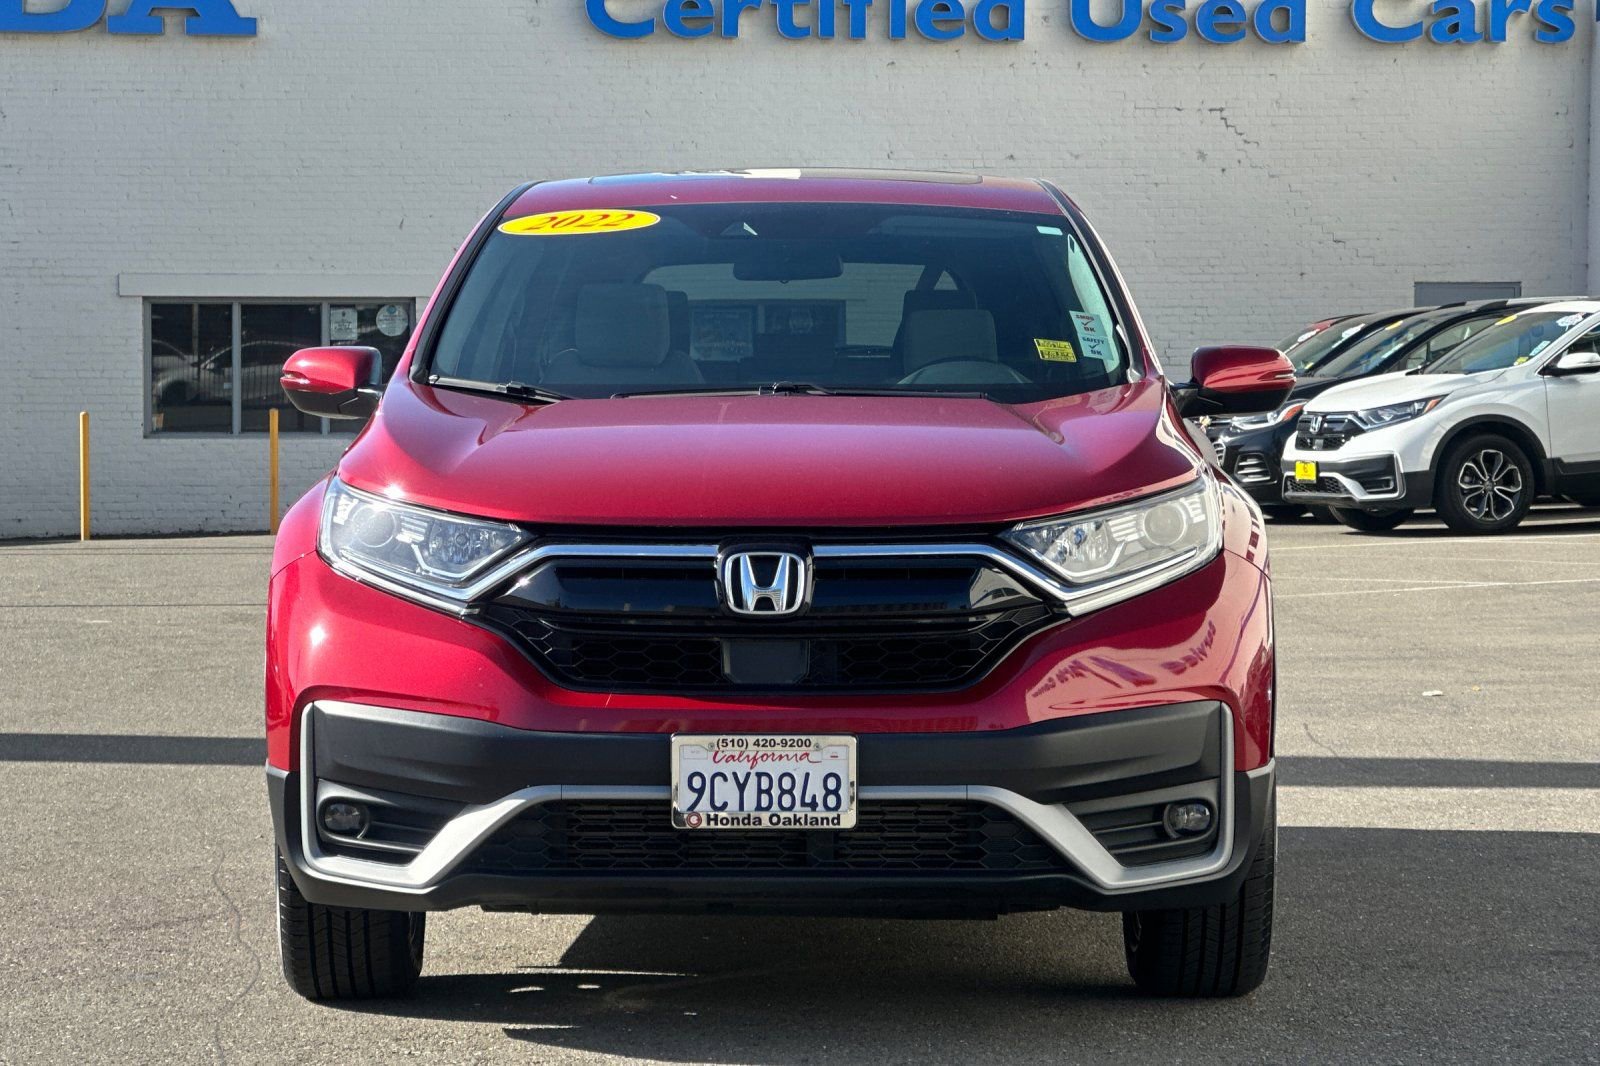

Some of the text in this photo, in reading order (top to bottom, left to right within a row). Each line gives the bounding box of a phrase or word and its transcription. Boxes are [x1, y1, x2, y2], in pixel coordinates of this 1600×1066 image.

[585, 0, 1575, 44] Certified Used Cars
[523, 213, 636, 231] 2022
[1082, 336, 1105, 345] SAFETY
[716, 738, 812, 749] (510) 420-9200
[712, 750, 822, 770] California
[686, 771, 842, 812] 9CYB848
[706, 814, 841, 827] Honda Oakland
